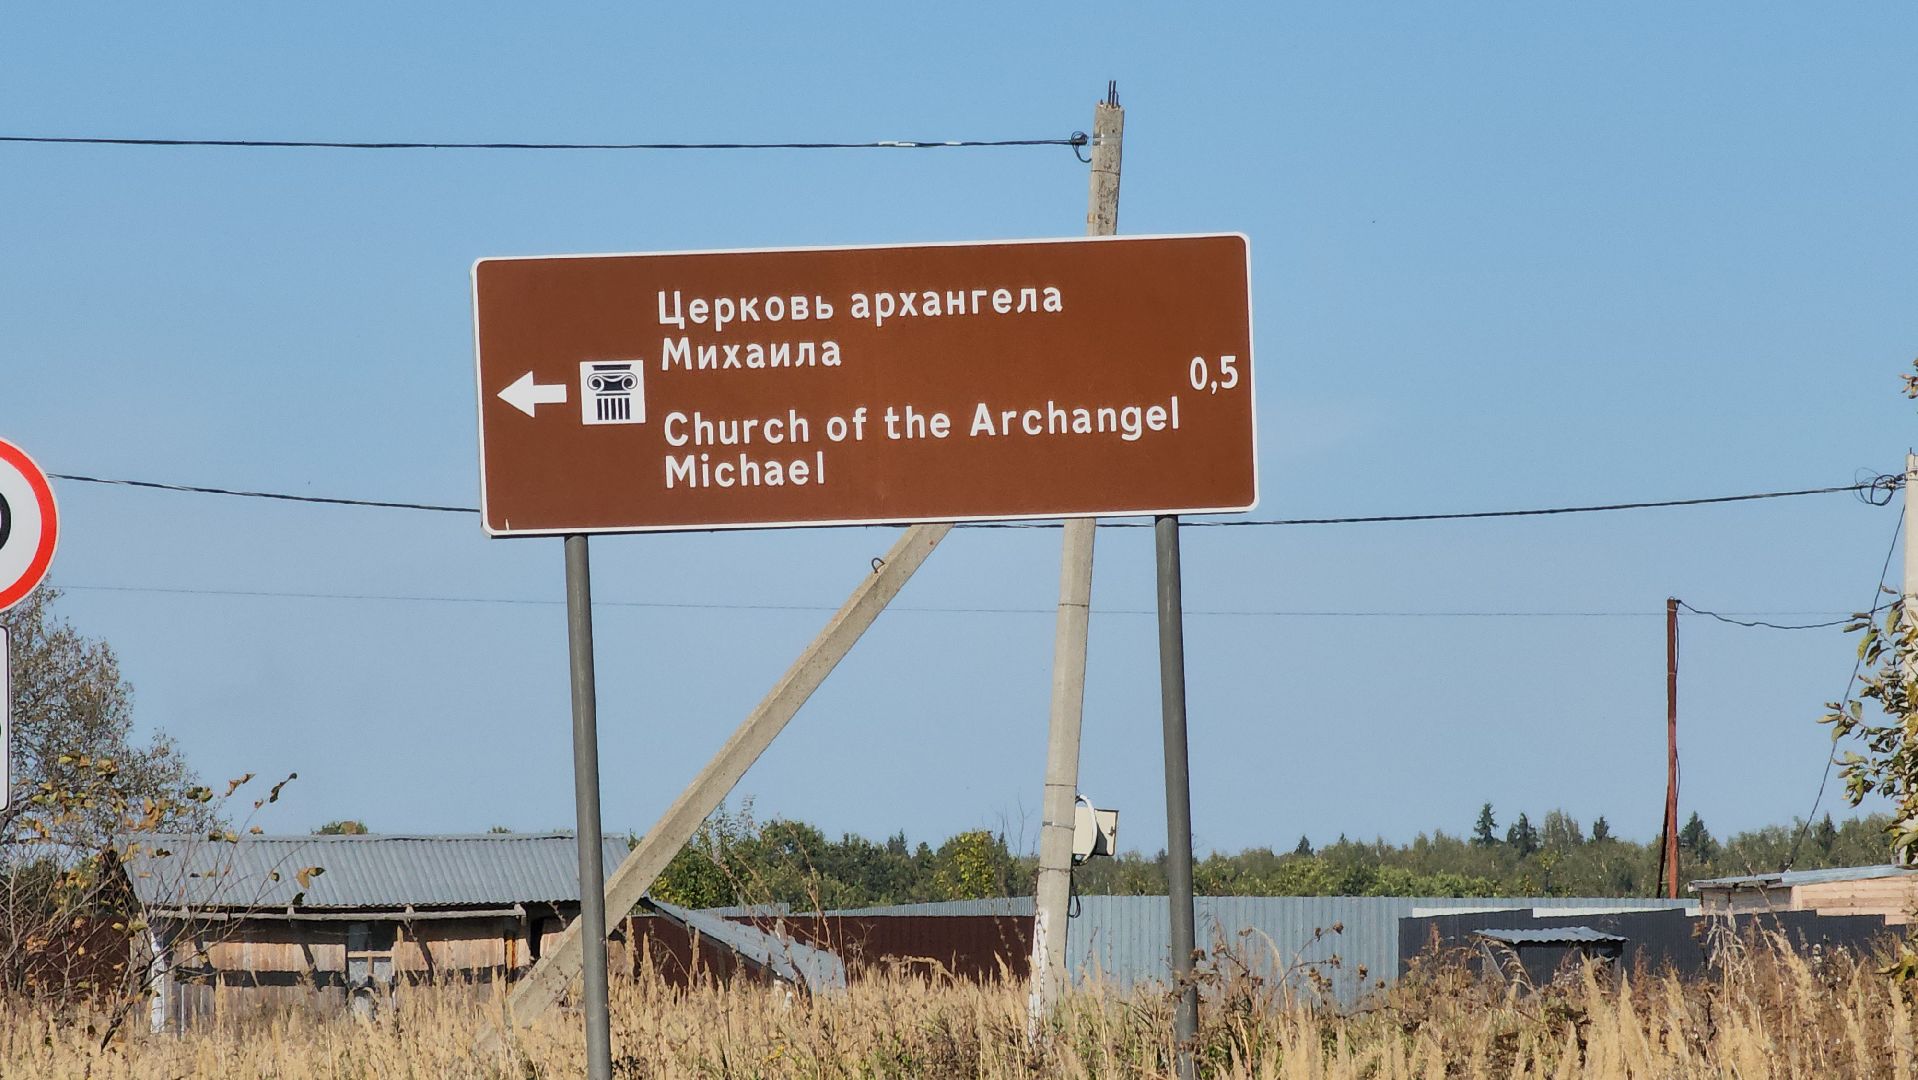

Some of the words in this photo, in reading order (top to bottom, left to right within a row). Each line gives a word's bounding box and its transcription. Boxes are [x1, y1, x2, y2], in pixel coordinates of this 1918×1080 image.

[658, 290, 834, 332] Церковь
[850, 286, 1063, 327] архангела
[661, 336, 842, 371] Михаила
[1189, 355, 1239, 395] 0,5
[664, 409, 809, 447] Church
[826, 406, 868, 442] of
[883, 405, 951, 440] the
[969, 395, 1180, 441] Archangel
[665, 450, 825, 489] Michael
